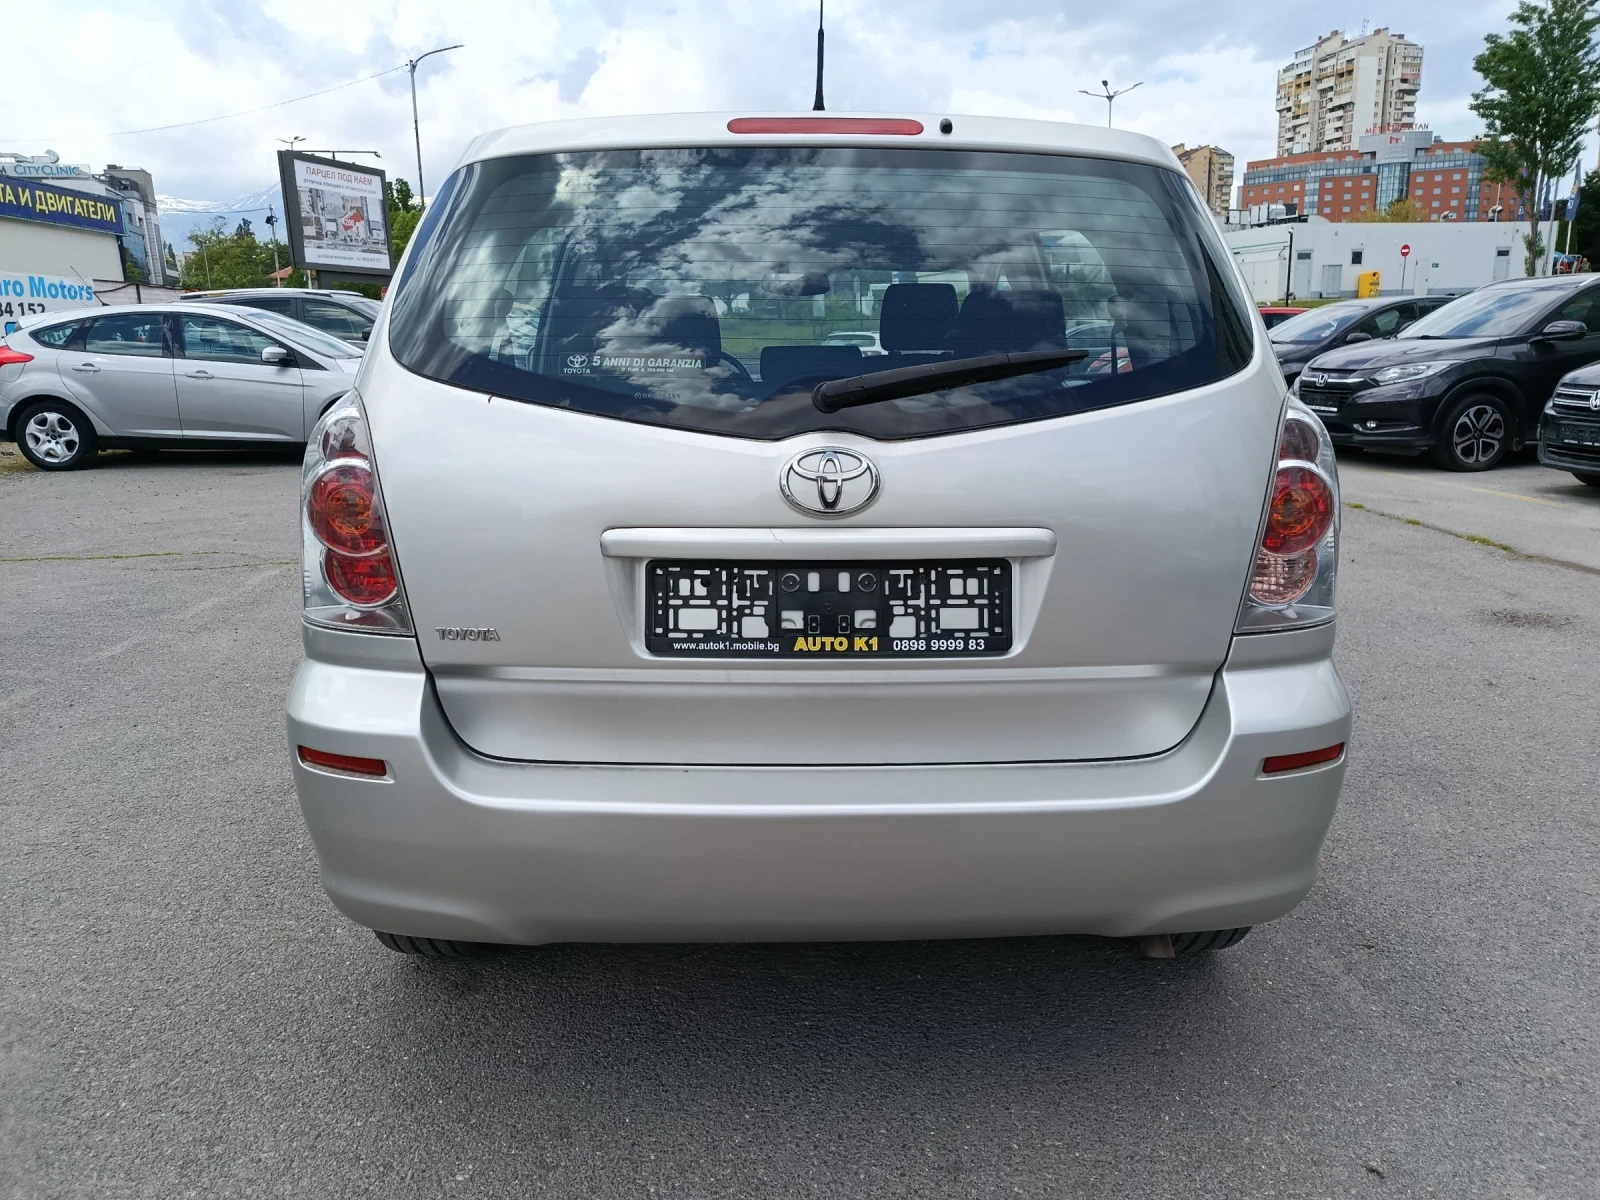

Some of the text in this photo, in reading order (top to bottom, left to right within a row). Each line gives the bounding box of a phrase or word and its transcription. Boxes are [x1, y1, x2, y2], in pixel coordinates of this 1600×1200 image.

[306, 166, 373, 187] ПАРЦЕЛ ПОД НАЕМ
[18, 187, 32, 208] И
[35, 190, 116, 223] ДВИГАТЕЛИ
[0, 275, 93, 301] ro Motors
[592, 355, 702, 369] 5 ANNI DI GARANZIA
[435, 626, 501, 641] TOYOTA
[673, 636, 985, 652] www.autok1.mobile.bg AUTO K1 0898 9999 83
